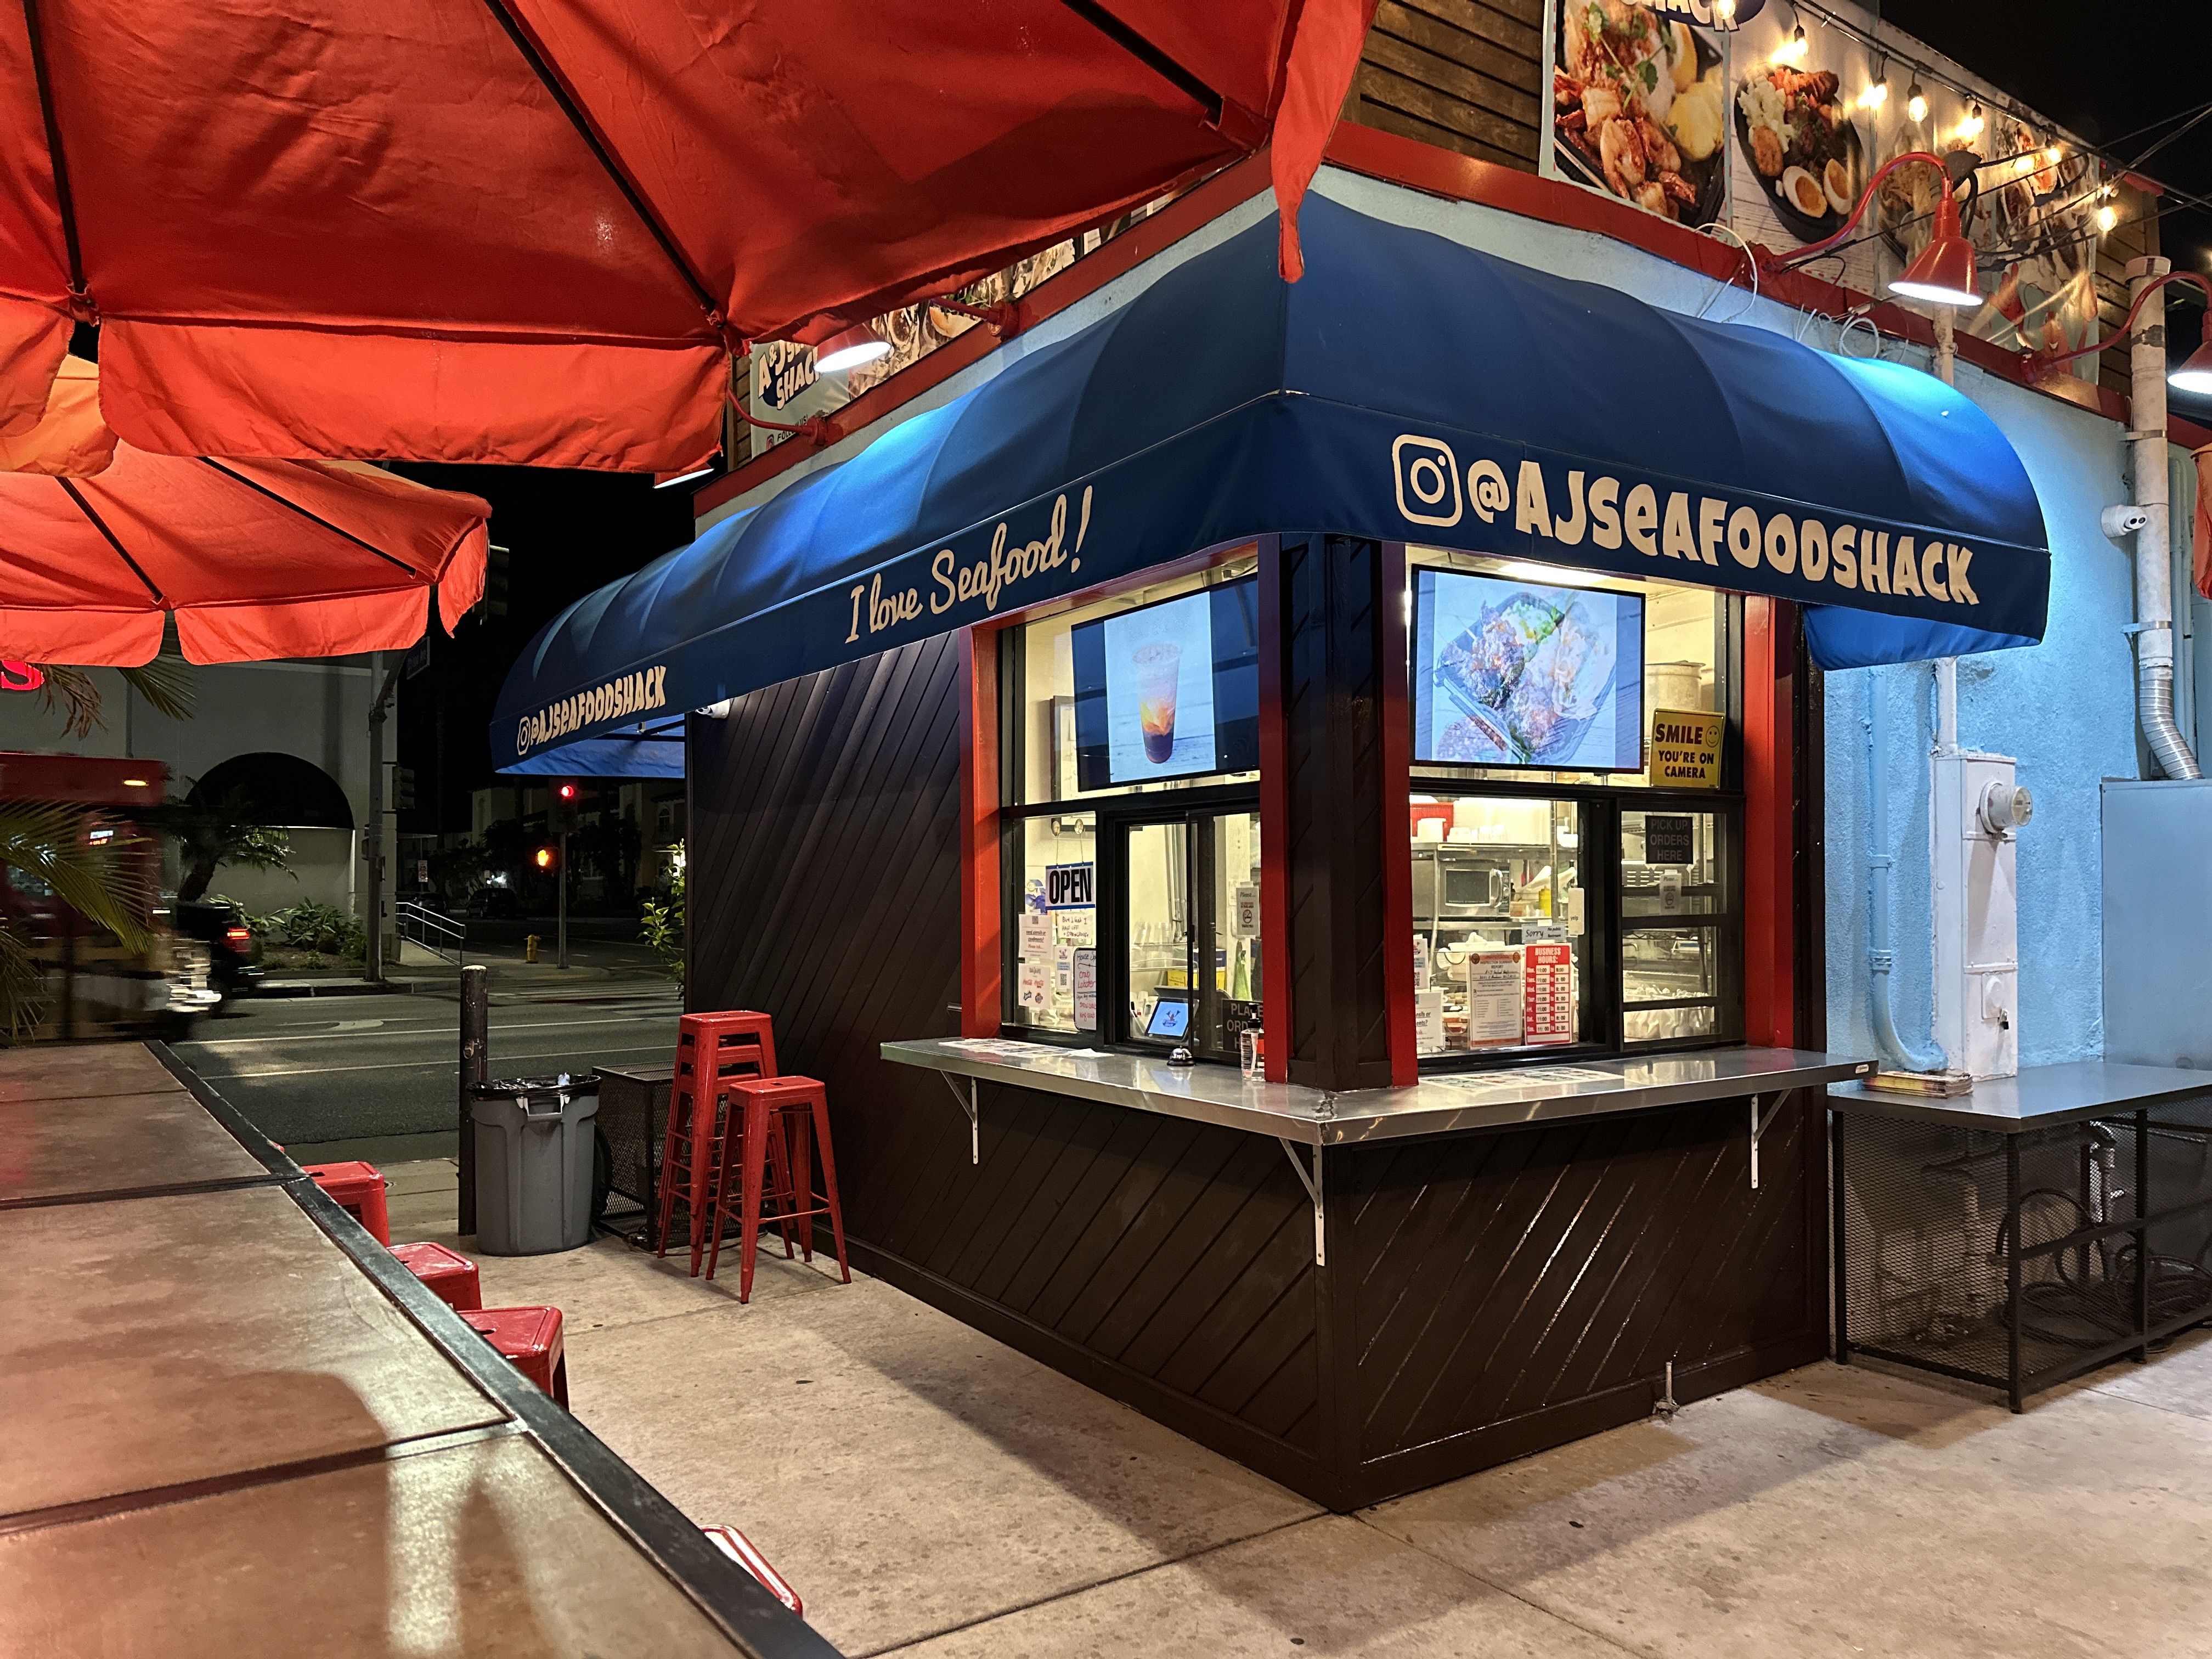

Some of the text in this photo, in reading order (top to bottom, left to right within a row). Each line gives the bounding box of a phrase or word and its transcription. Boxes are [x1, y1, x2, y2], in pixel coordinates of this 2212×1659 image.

[845, 585, 864, 644] I
[870, 573, 923, 634] love
[1655, 723, 1703, 744] SMILE
[1658, 750, 1714, 764] YOU'RE ON
[1664, 766, 1706, 779] CAMERA
[1651, 819, 1688, 830] PICK UP
[1650, 834, 1689, 845] ORDERS
[1657, 850, 1683, 861] HERE
[1049, 868, 1092, 904] OPEN
[1526, 929, 1544, 939] Sorry
[1535, 947, 1561, 956] BUSINESS
[1231, 1003, 1263, 1018] PLAE
